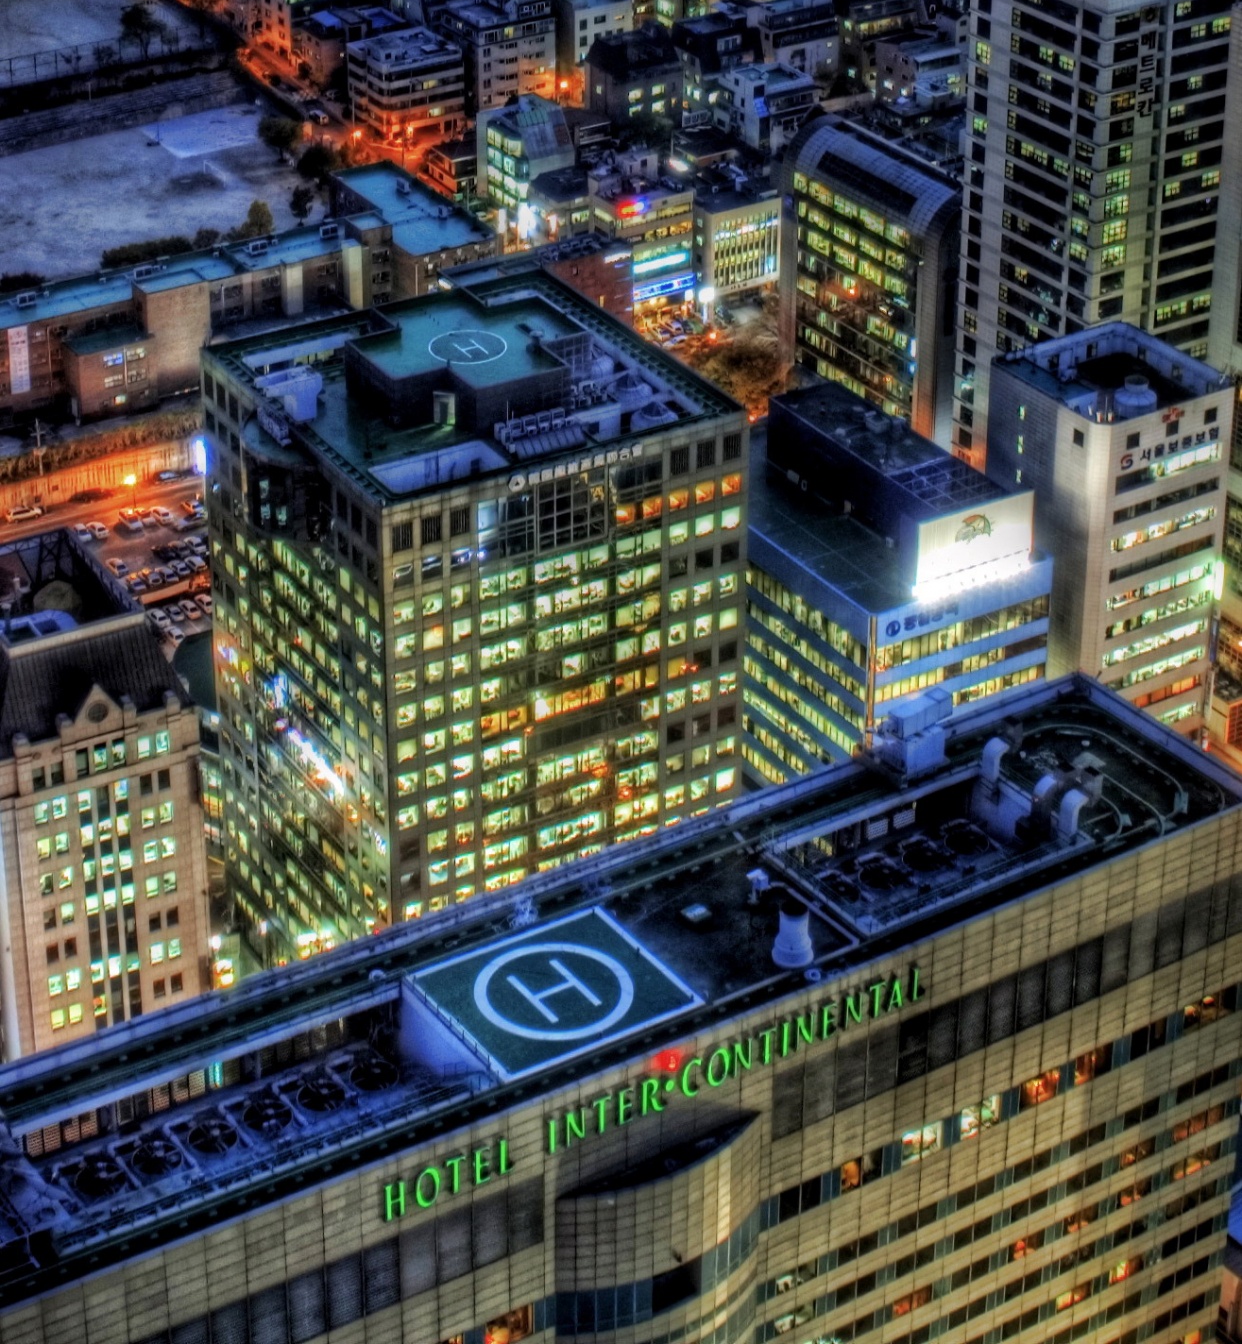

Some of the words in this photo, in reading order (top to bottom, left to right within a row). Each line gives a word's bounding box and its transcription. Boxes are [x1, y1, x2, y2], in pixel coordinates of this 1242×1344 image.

[1137, 30, 1157, 118] 메트로칸
[452, 338, 489, 359] H
[506, 959, 602, 1024] H
[384, 1138, 515, 1222] HOTEL
